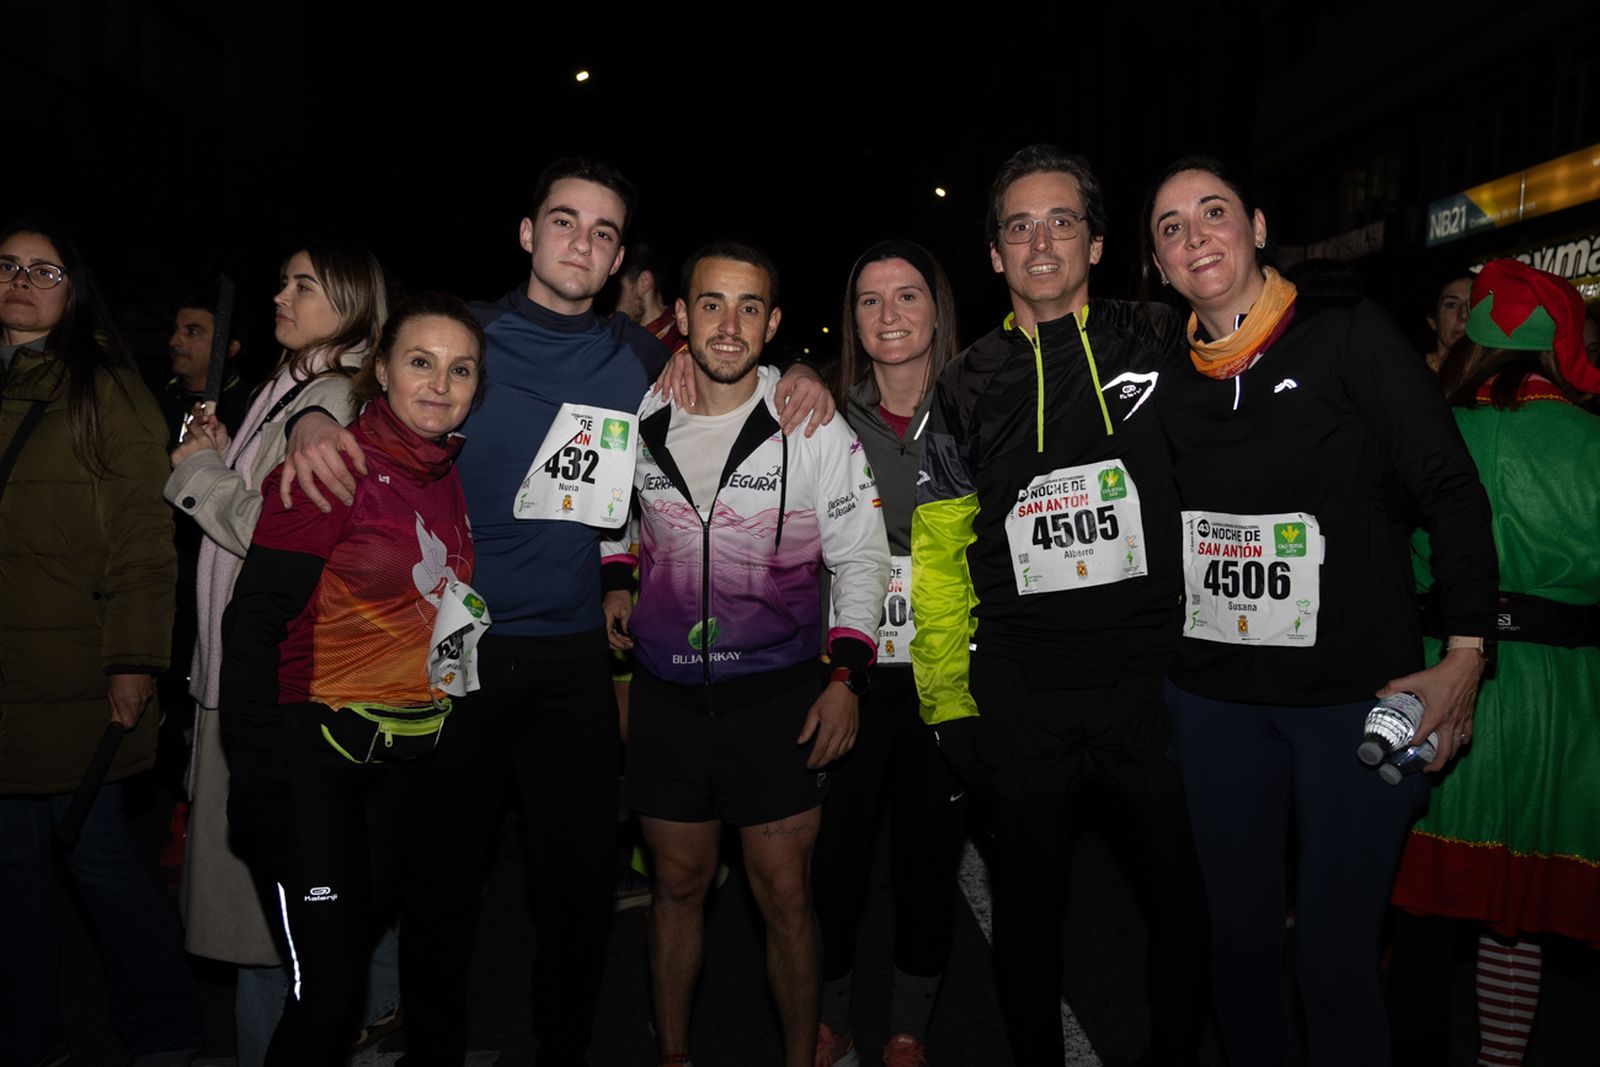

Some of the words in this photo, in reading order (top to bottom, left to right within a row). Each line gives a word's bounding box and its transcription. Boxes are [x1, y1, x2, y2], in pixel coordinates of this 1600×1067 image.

[1429, 205, 1467, 240] NB21
[558, 482, 580, 493] Nuria
[1030, 482, 1069, 499] NOCHE
[1071, 479, 1086, 492] DE
[1018, 500, 1043, 517] SAN
[1032, 504, 1120, 551] 4505
[1211, 527, 1242, 542] NOCHE
[1244, 530, 1261, 542] DE
[1198, 541, 1221, 556] SAN
[1222, 542, 1262, 559] ANTÓN
[1203, 559, 1291, 600] 4506
[1227, 600, 1258, 612] Susana
[878, 629, 899, 638] Elena
[303, 893, 338, 902] Kalenji
